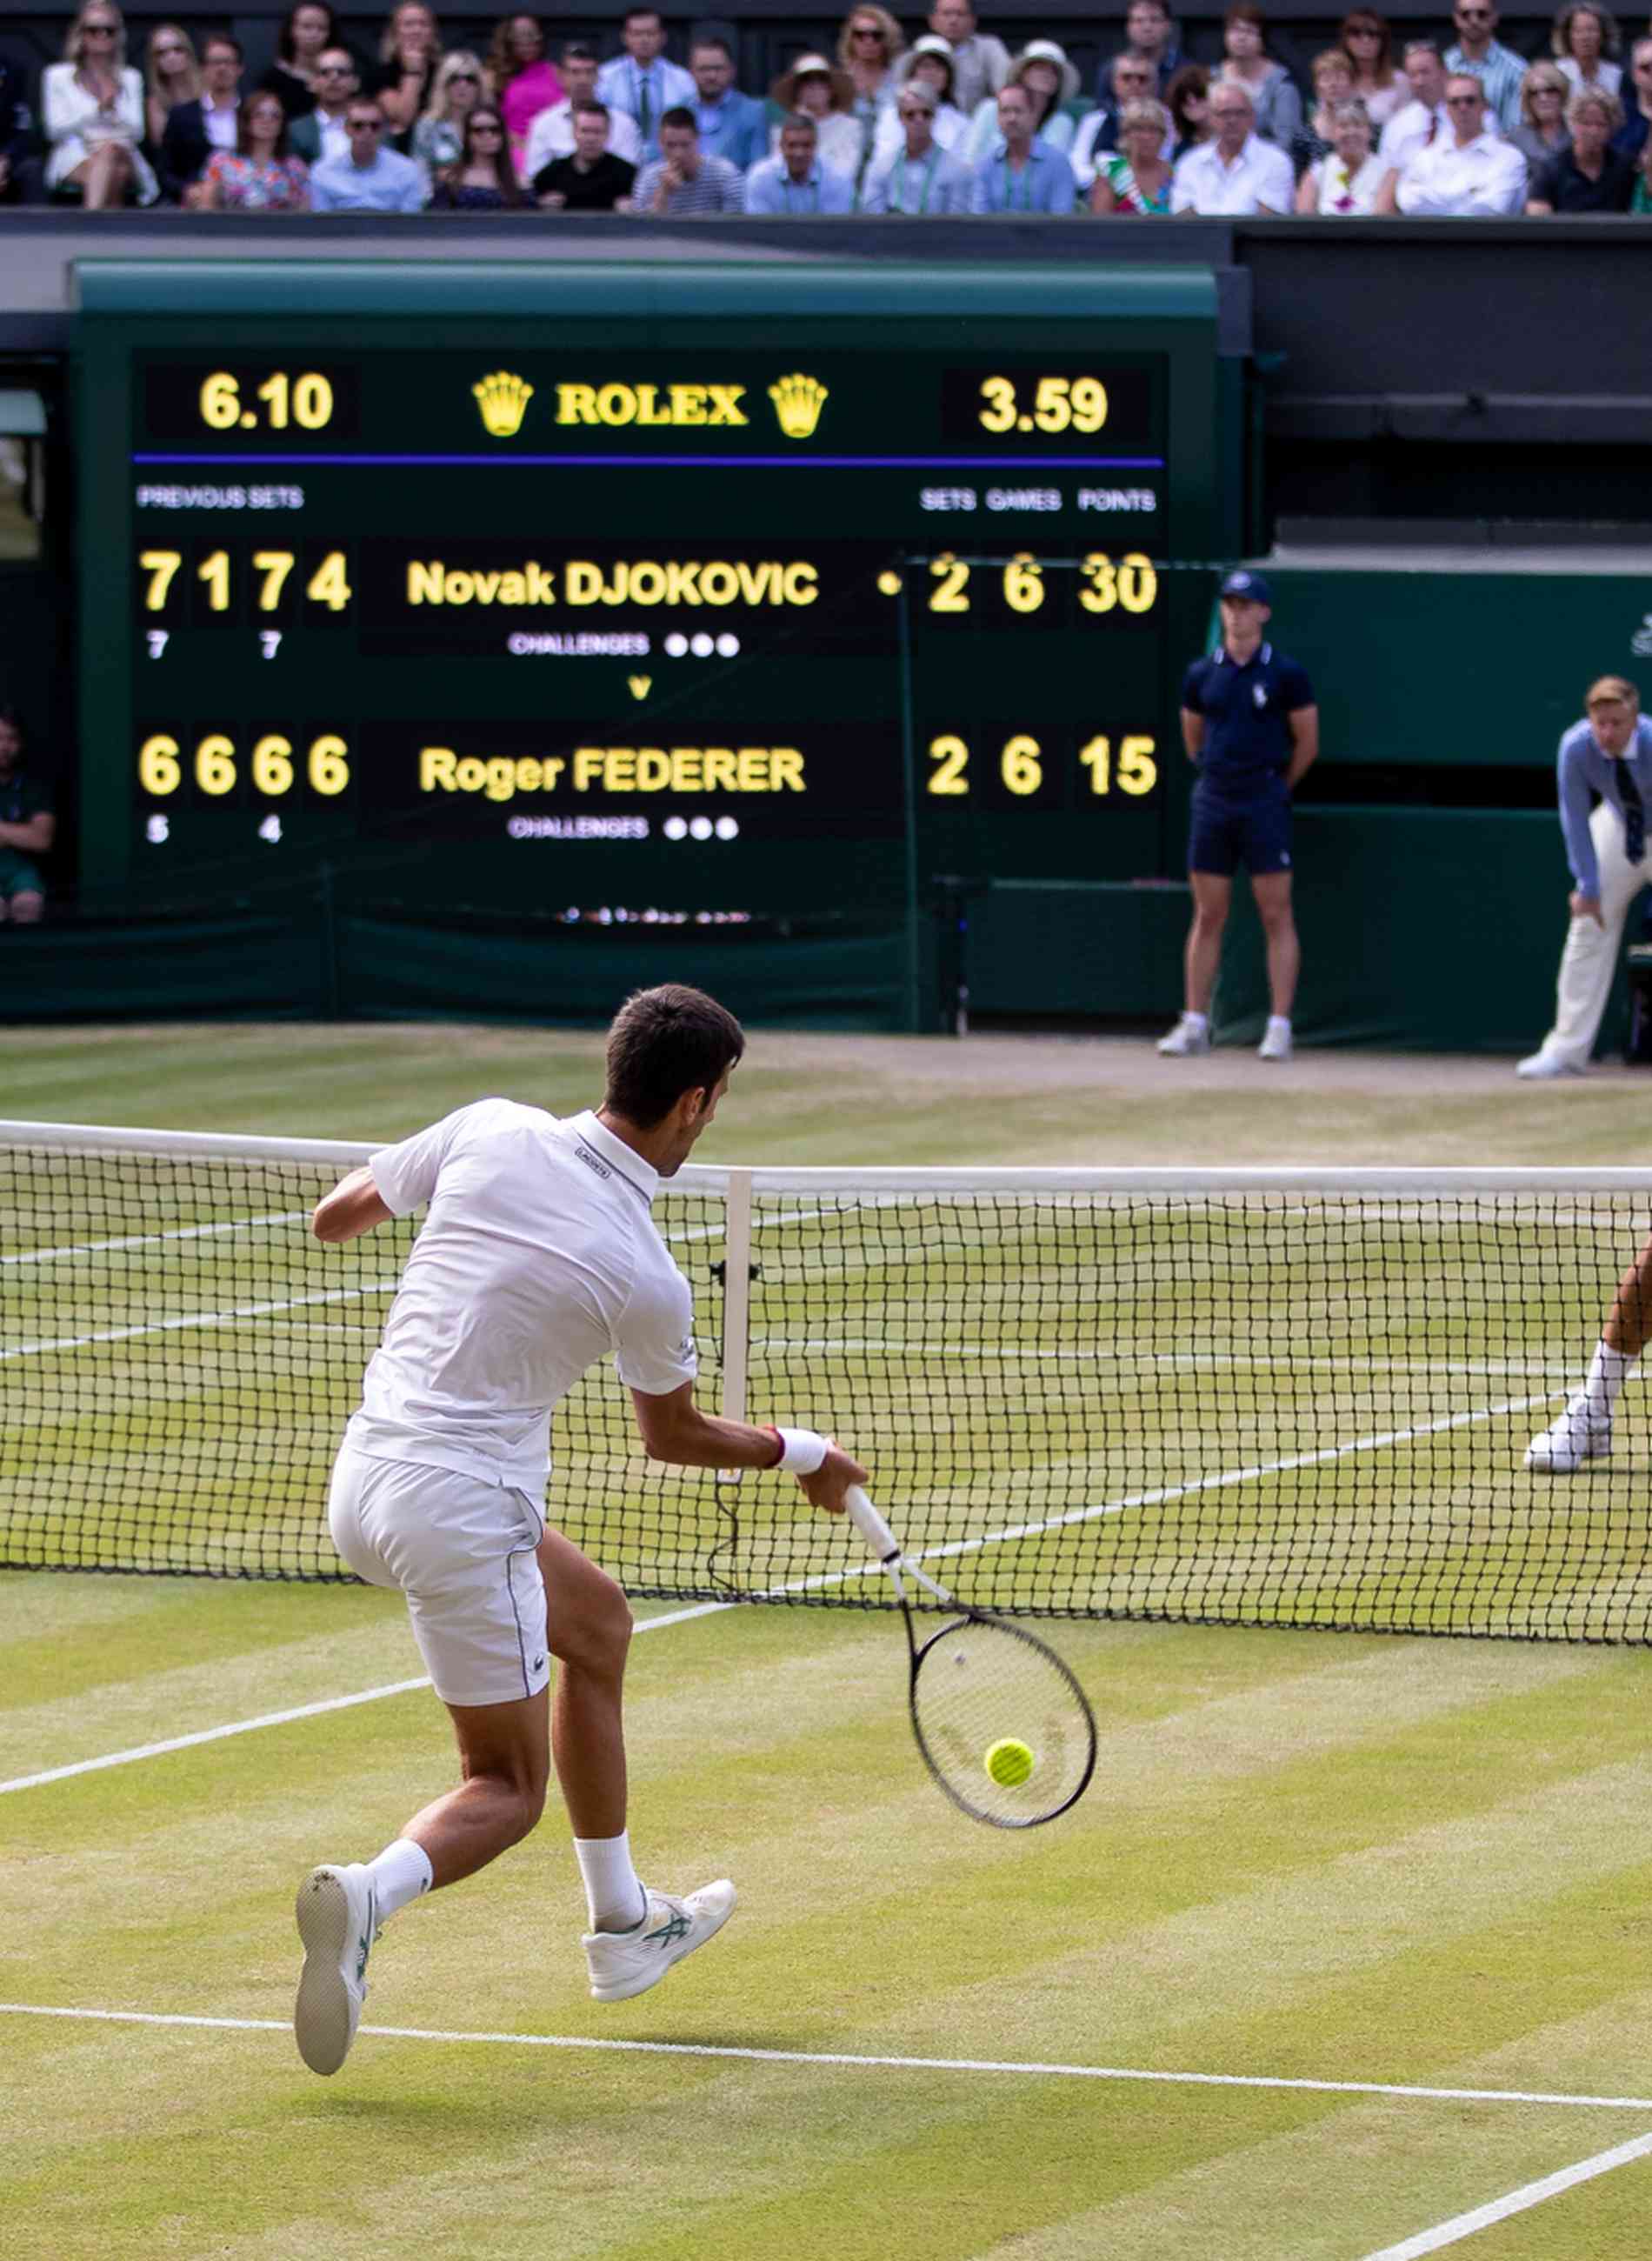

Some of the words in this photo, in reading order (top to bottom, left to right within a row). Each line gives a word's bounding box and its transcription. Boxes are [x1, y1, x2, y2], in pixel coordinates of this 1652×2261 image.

[201, 373, 333, 429] 6.10
[556, 384, 749, 425] ROLEX
[980, 377, 1108, 432] 3.59
[137, 486, 248, 509] PREVIOUS
[248, 486, 304, 509] SETS
[921, 489, 976, 510] SETS
[986, 489, 1062, 510] GAMES
[1078, 489, 1156, 511] POINTS
[141, 551, 181, 610] 7
[199, 551, 229, 610] 1
[254, 551, 294, 610] 7
[308, 552, 351, 610] 4
[408, 562, 556, 604] Novak
[566, 562, 818, 605] DJOKOVIC
[929, 552, 969, 613] 2
[1003, 553, 1044, 613] 6
[1079, 552, 1157, 613] 30
[148, 630, 169, 658] 7
[260, 630, 282, 659] 7
[509, 633, 649, 656] CHALLENGES
[140, 735, 180, 795] 6
[196, 735, 236, 795] 6
[253, 736, 293, 795] 6
[309, 736, 349, 795] 6
[421, 748, 564, 801] Roger
[574, 748, 805, 791] FEDERER
[929, 736, 969, 794] 2
[1002, 736, 1042, 795] 6
[1080, 736, 1156, 795] 15
[259, 815, 282, 843] 4
[508, 817, 649, 838] CHALLENGES
